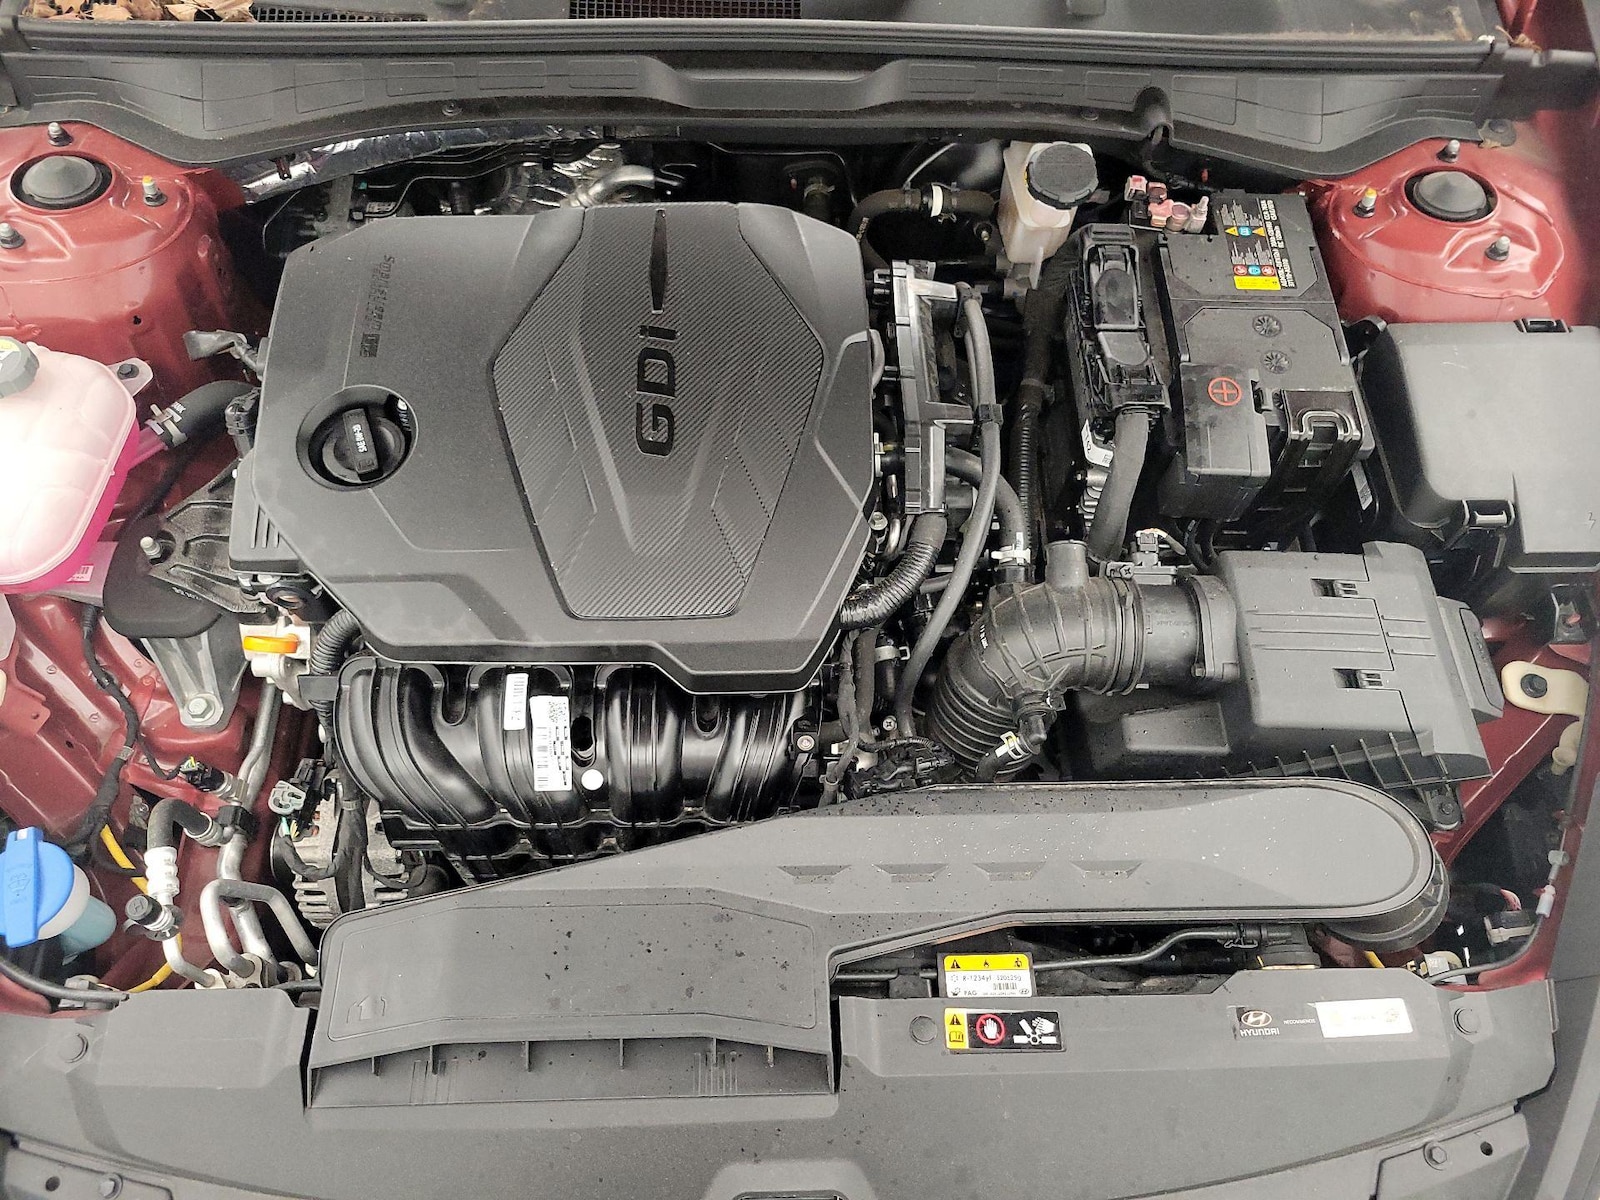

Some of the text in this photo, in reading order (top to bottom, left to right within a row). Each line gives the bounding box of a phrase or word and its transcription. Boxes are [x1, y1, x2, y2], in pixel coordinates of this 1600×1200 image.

[635, 324, 677, 458] GDi
[356, 440, 368, 453] SAE
[1239, 1027, 1280, 1037] HYUNDAI
